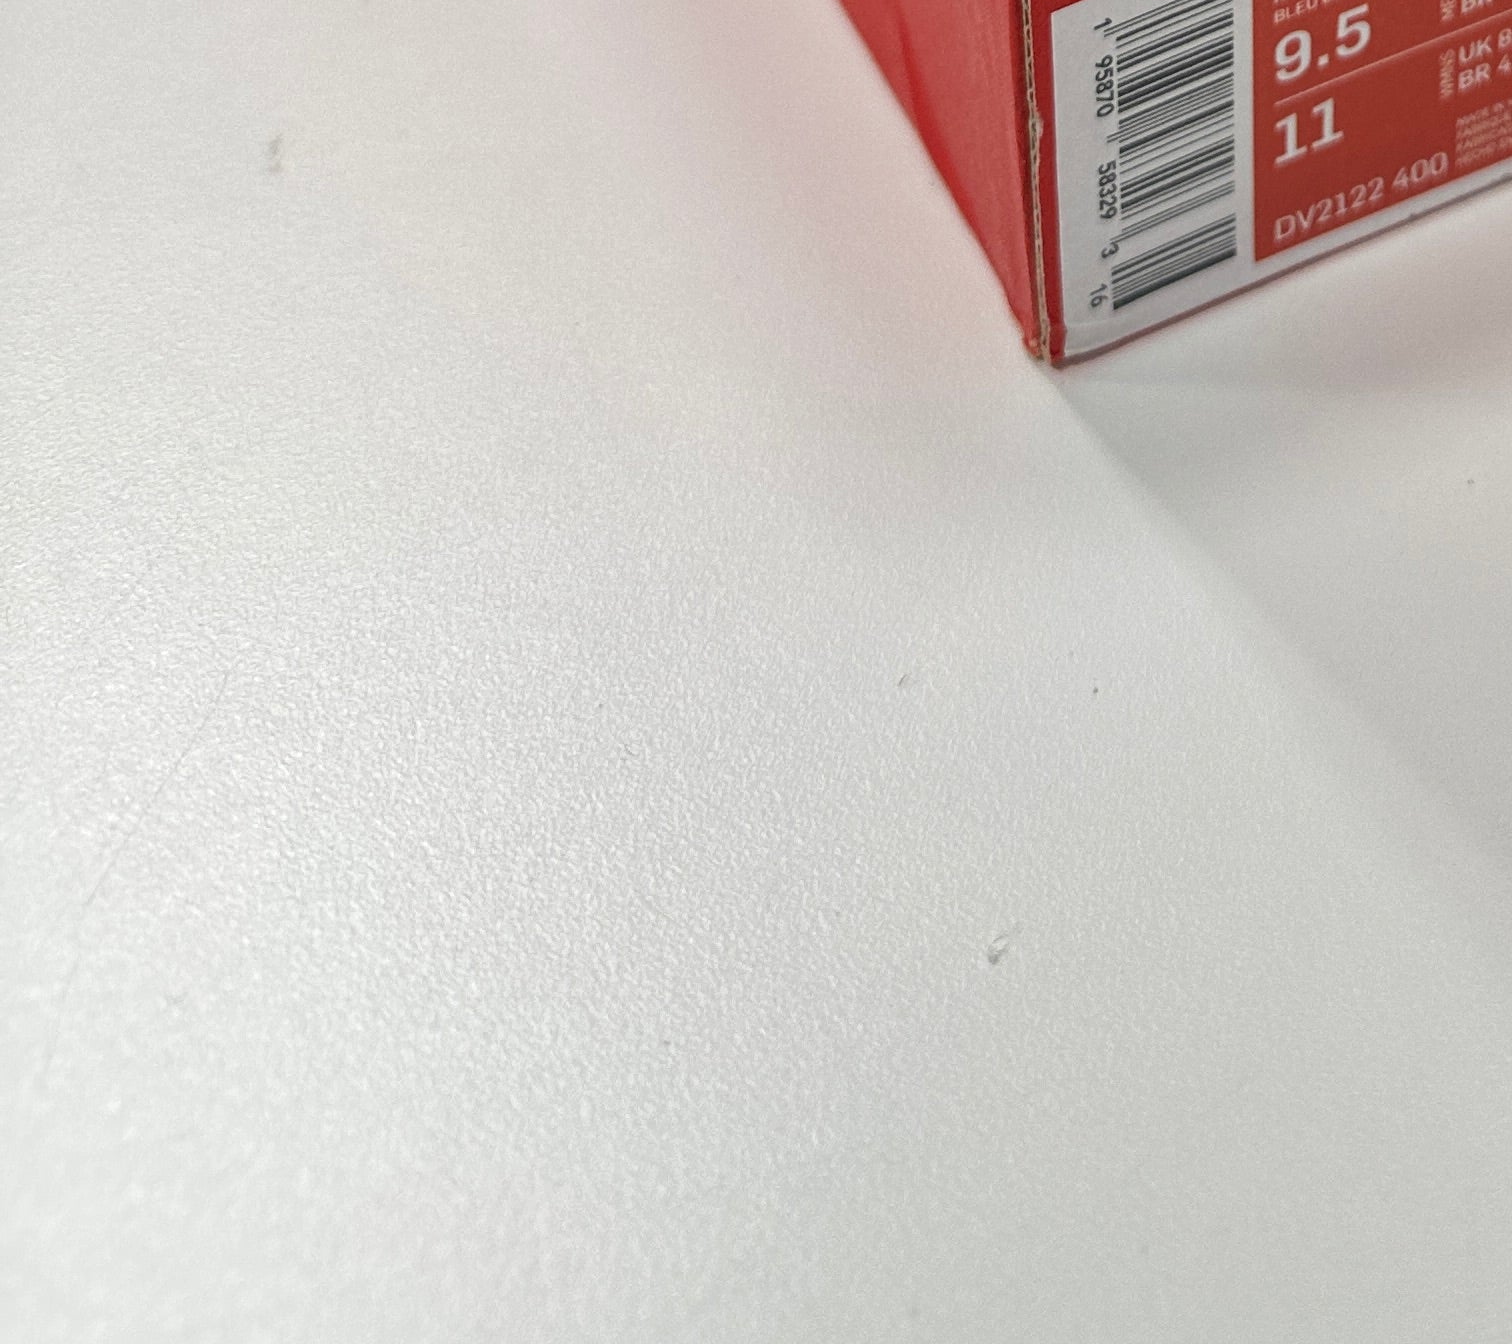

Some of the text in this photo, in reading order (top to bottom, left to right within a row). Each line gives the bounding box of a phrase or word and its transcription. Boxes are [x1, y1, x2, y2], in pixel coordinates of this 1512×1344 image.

[1274, 3, 1371, 82] 9.5
[1458, 36, 1493, 64] UK
[1458, 63, 1492, 91] BR
[1093, 17, 1120, 260] 1 95870 58329 3
[1274, 97, 1344, 165] 11
[1274, 151, 1450, 242] DV2122 400
[1090, 283, 1109, 308] 16
